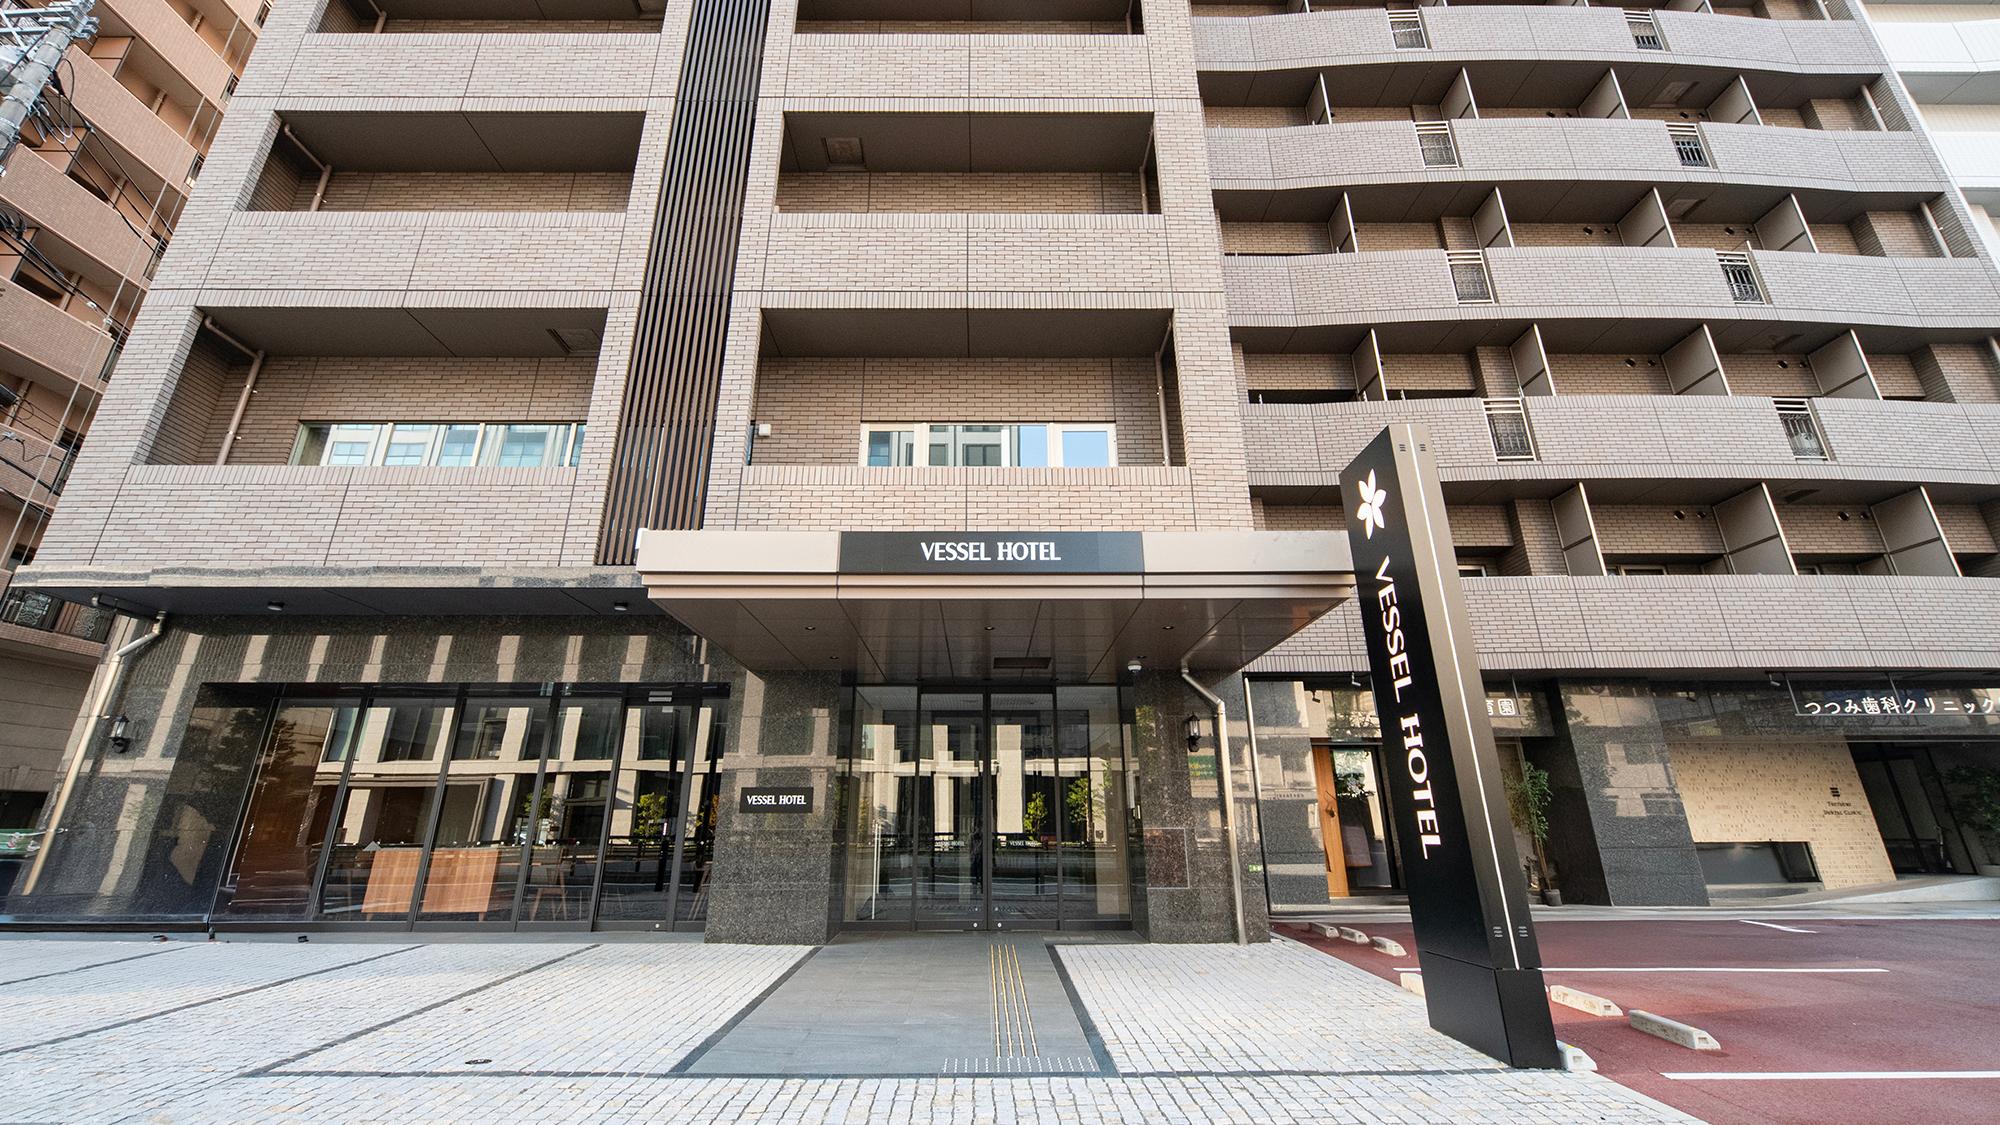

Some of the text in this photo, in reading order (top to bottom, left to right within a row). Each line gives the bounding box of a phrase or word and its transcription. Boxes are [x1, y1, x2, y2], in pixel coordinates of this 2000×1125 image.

[920, 541, 1062, 561] VESSEL HOTEL
[1375, 555, 1441, 860] VESSEL HOTEL
[1804, 696, 1994, 715] つつみ歯科クリニック
[746, 794, 807, 805] VESSEL HOTEL
